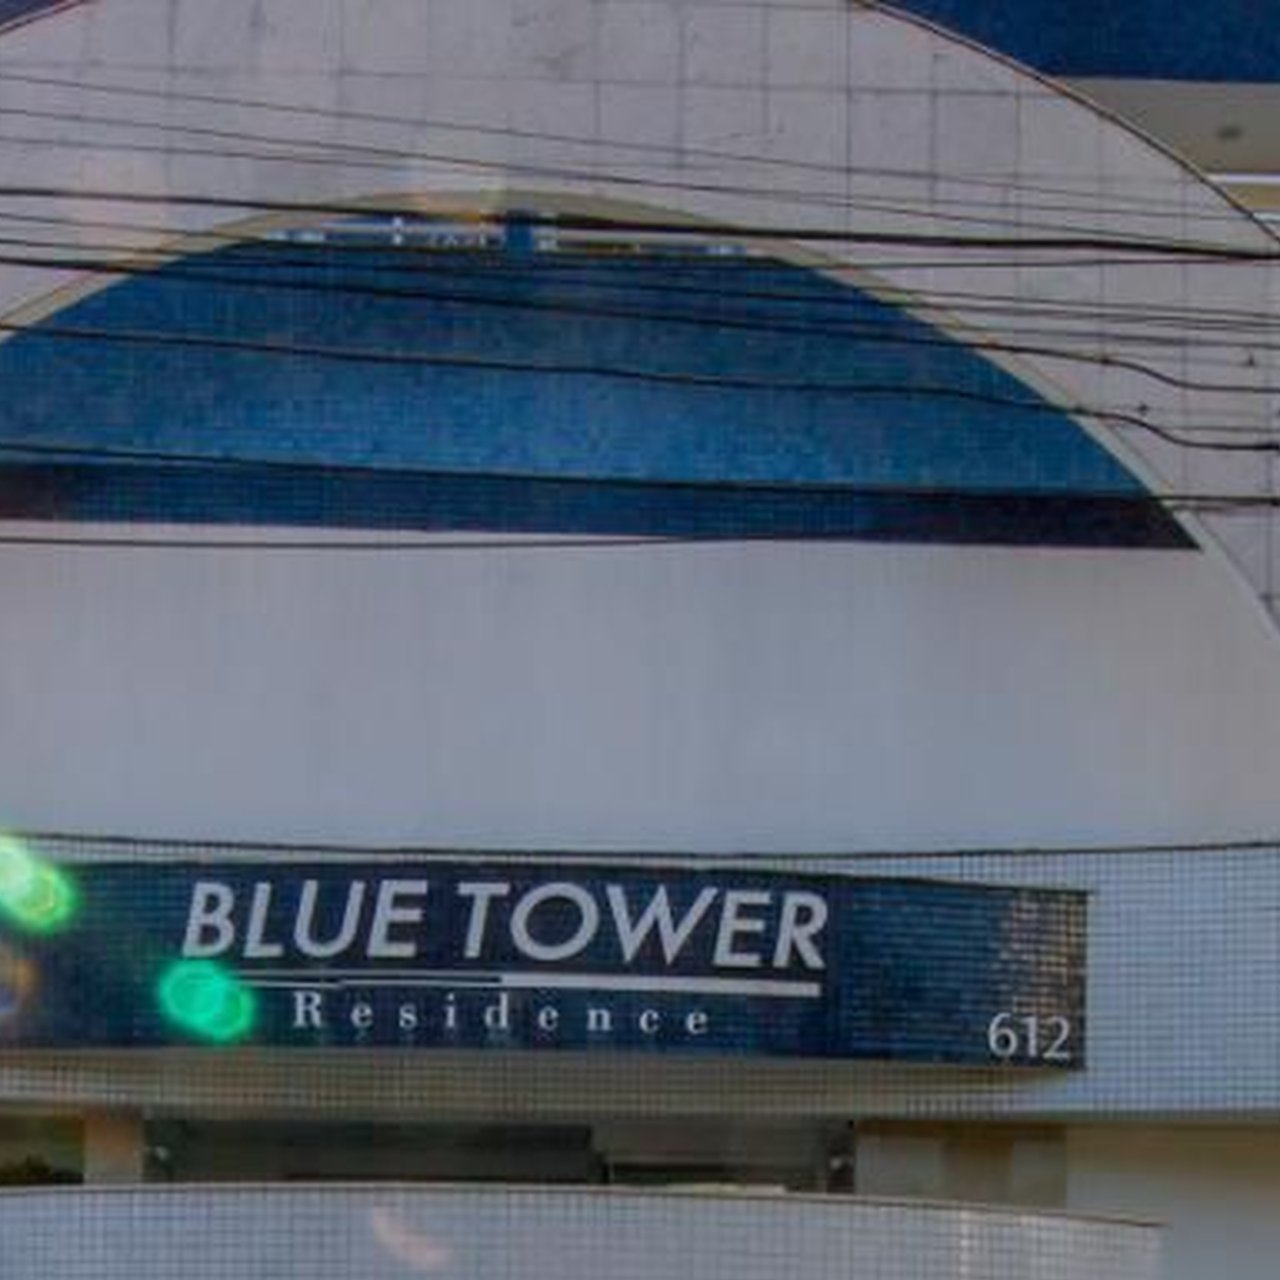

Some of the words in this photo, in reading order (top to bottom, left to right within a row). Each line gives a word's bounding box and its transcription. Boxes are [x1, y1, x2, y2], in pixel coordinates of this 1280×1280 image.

[182, 879, 428, 958] BLUE
[458, 881, 829, 969] TOWER
[291, 990, 709, 1035] Residence
[987, 1012, 1070, 1059] 612
